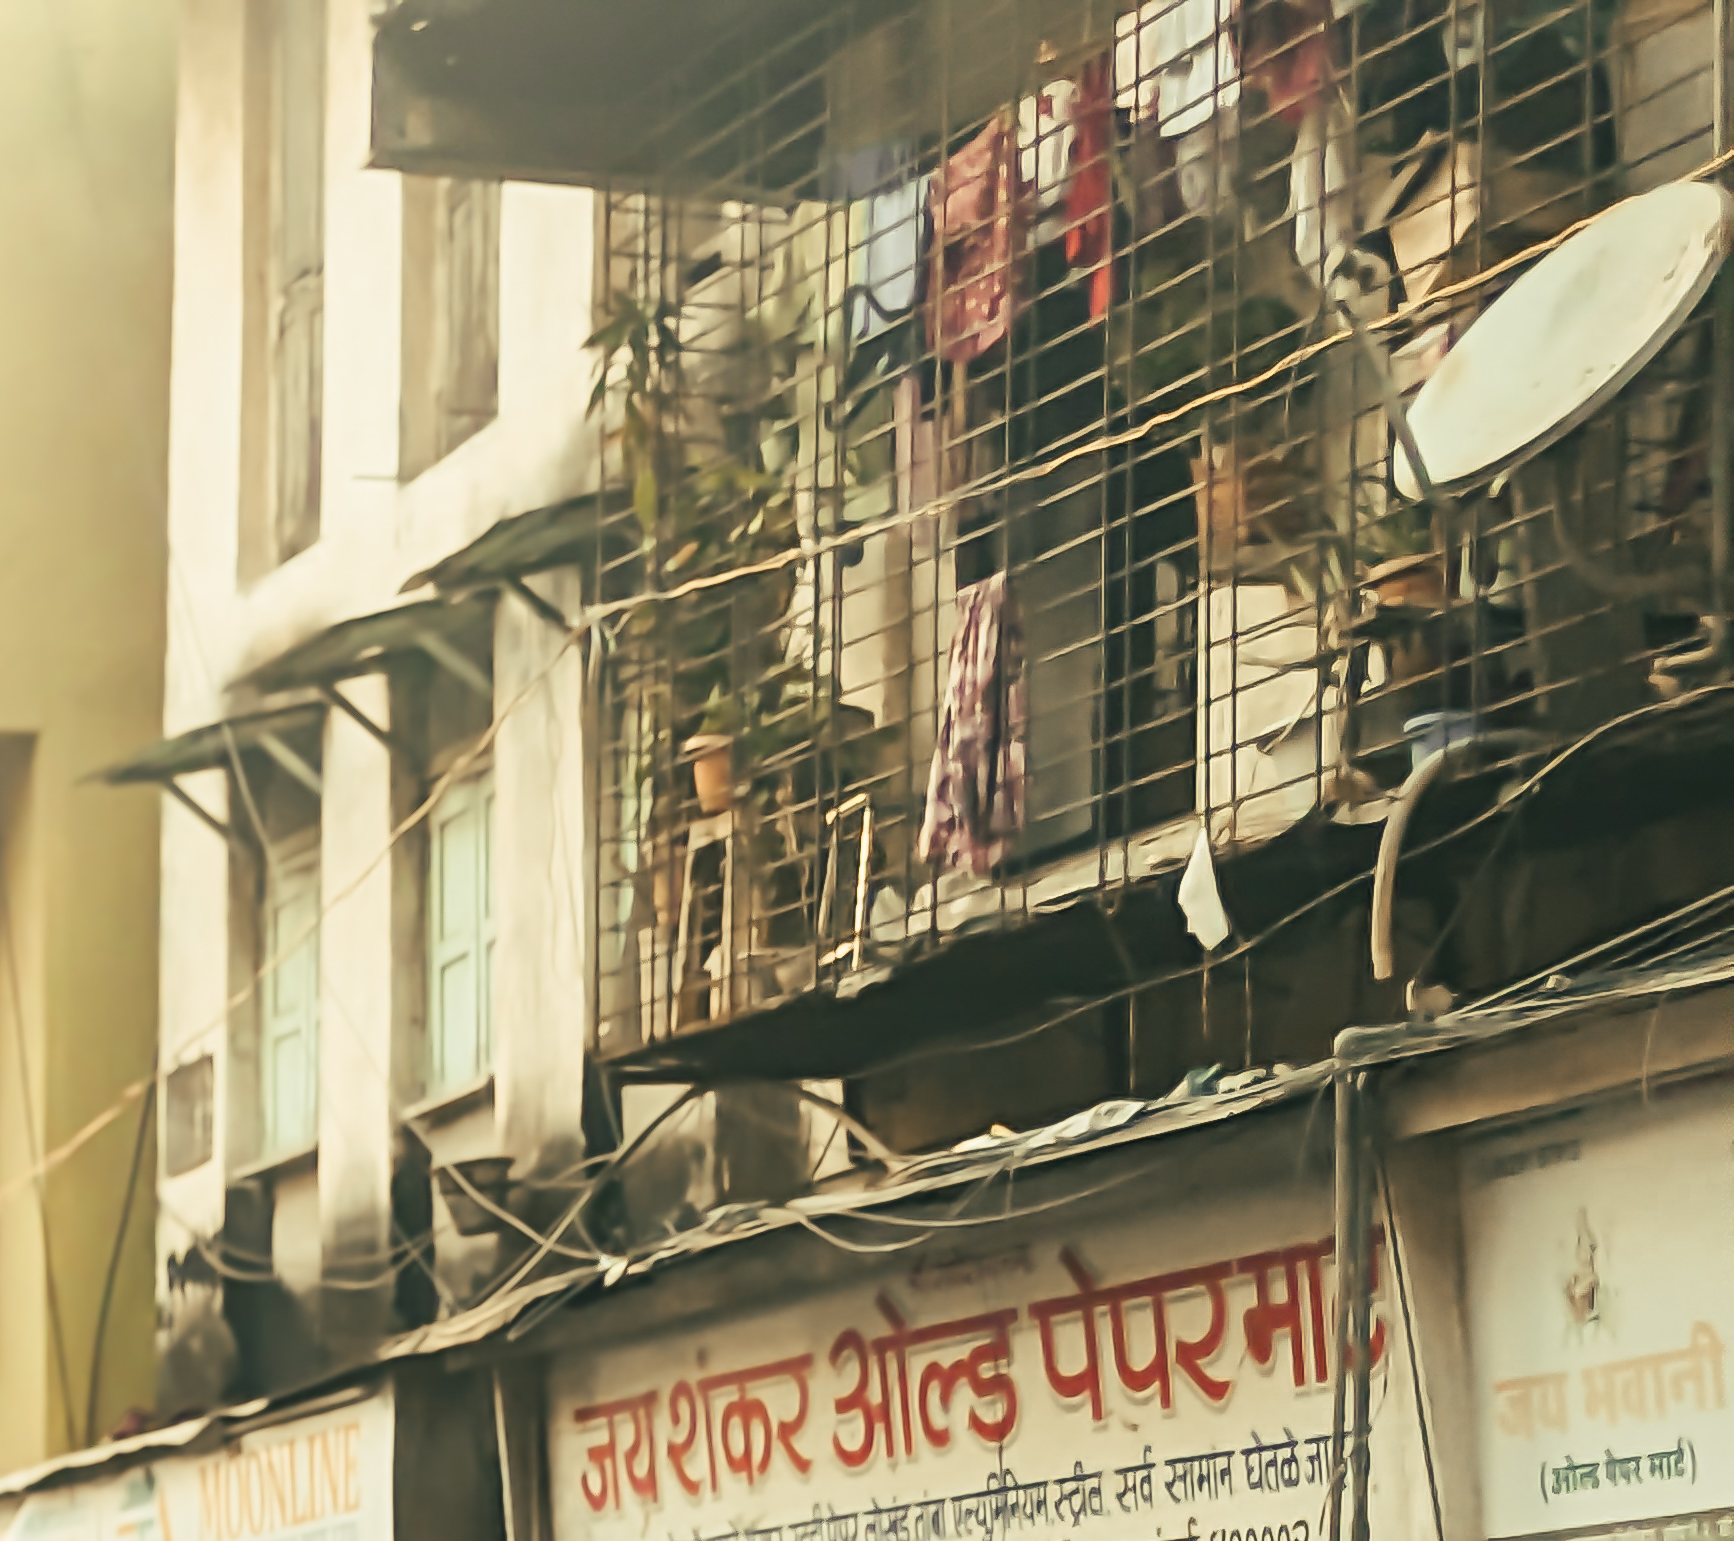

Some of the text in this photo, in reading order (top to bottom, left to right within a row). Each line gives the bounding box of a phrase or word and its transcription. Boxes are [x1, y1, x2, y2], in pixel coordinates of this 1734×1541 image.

[573, 1388, 660, 1512] जय
[667, 1345, 815, 1497] शंकर
[829, 1285, 1019, 1468] ओल्ड
[1113, 1445, 1156, 1513] सर्व
